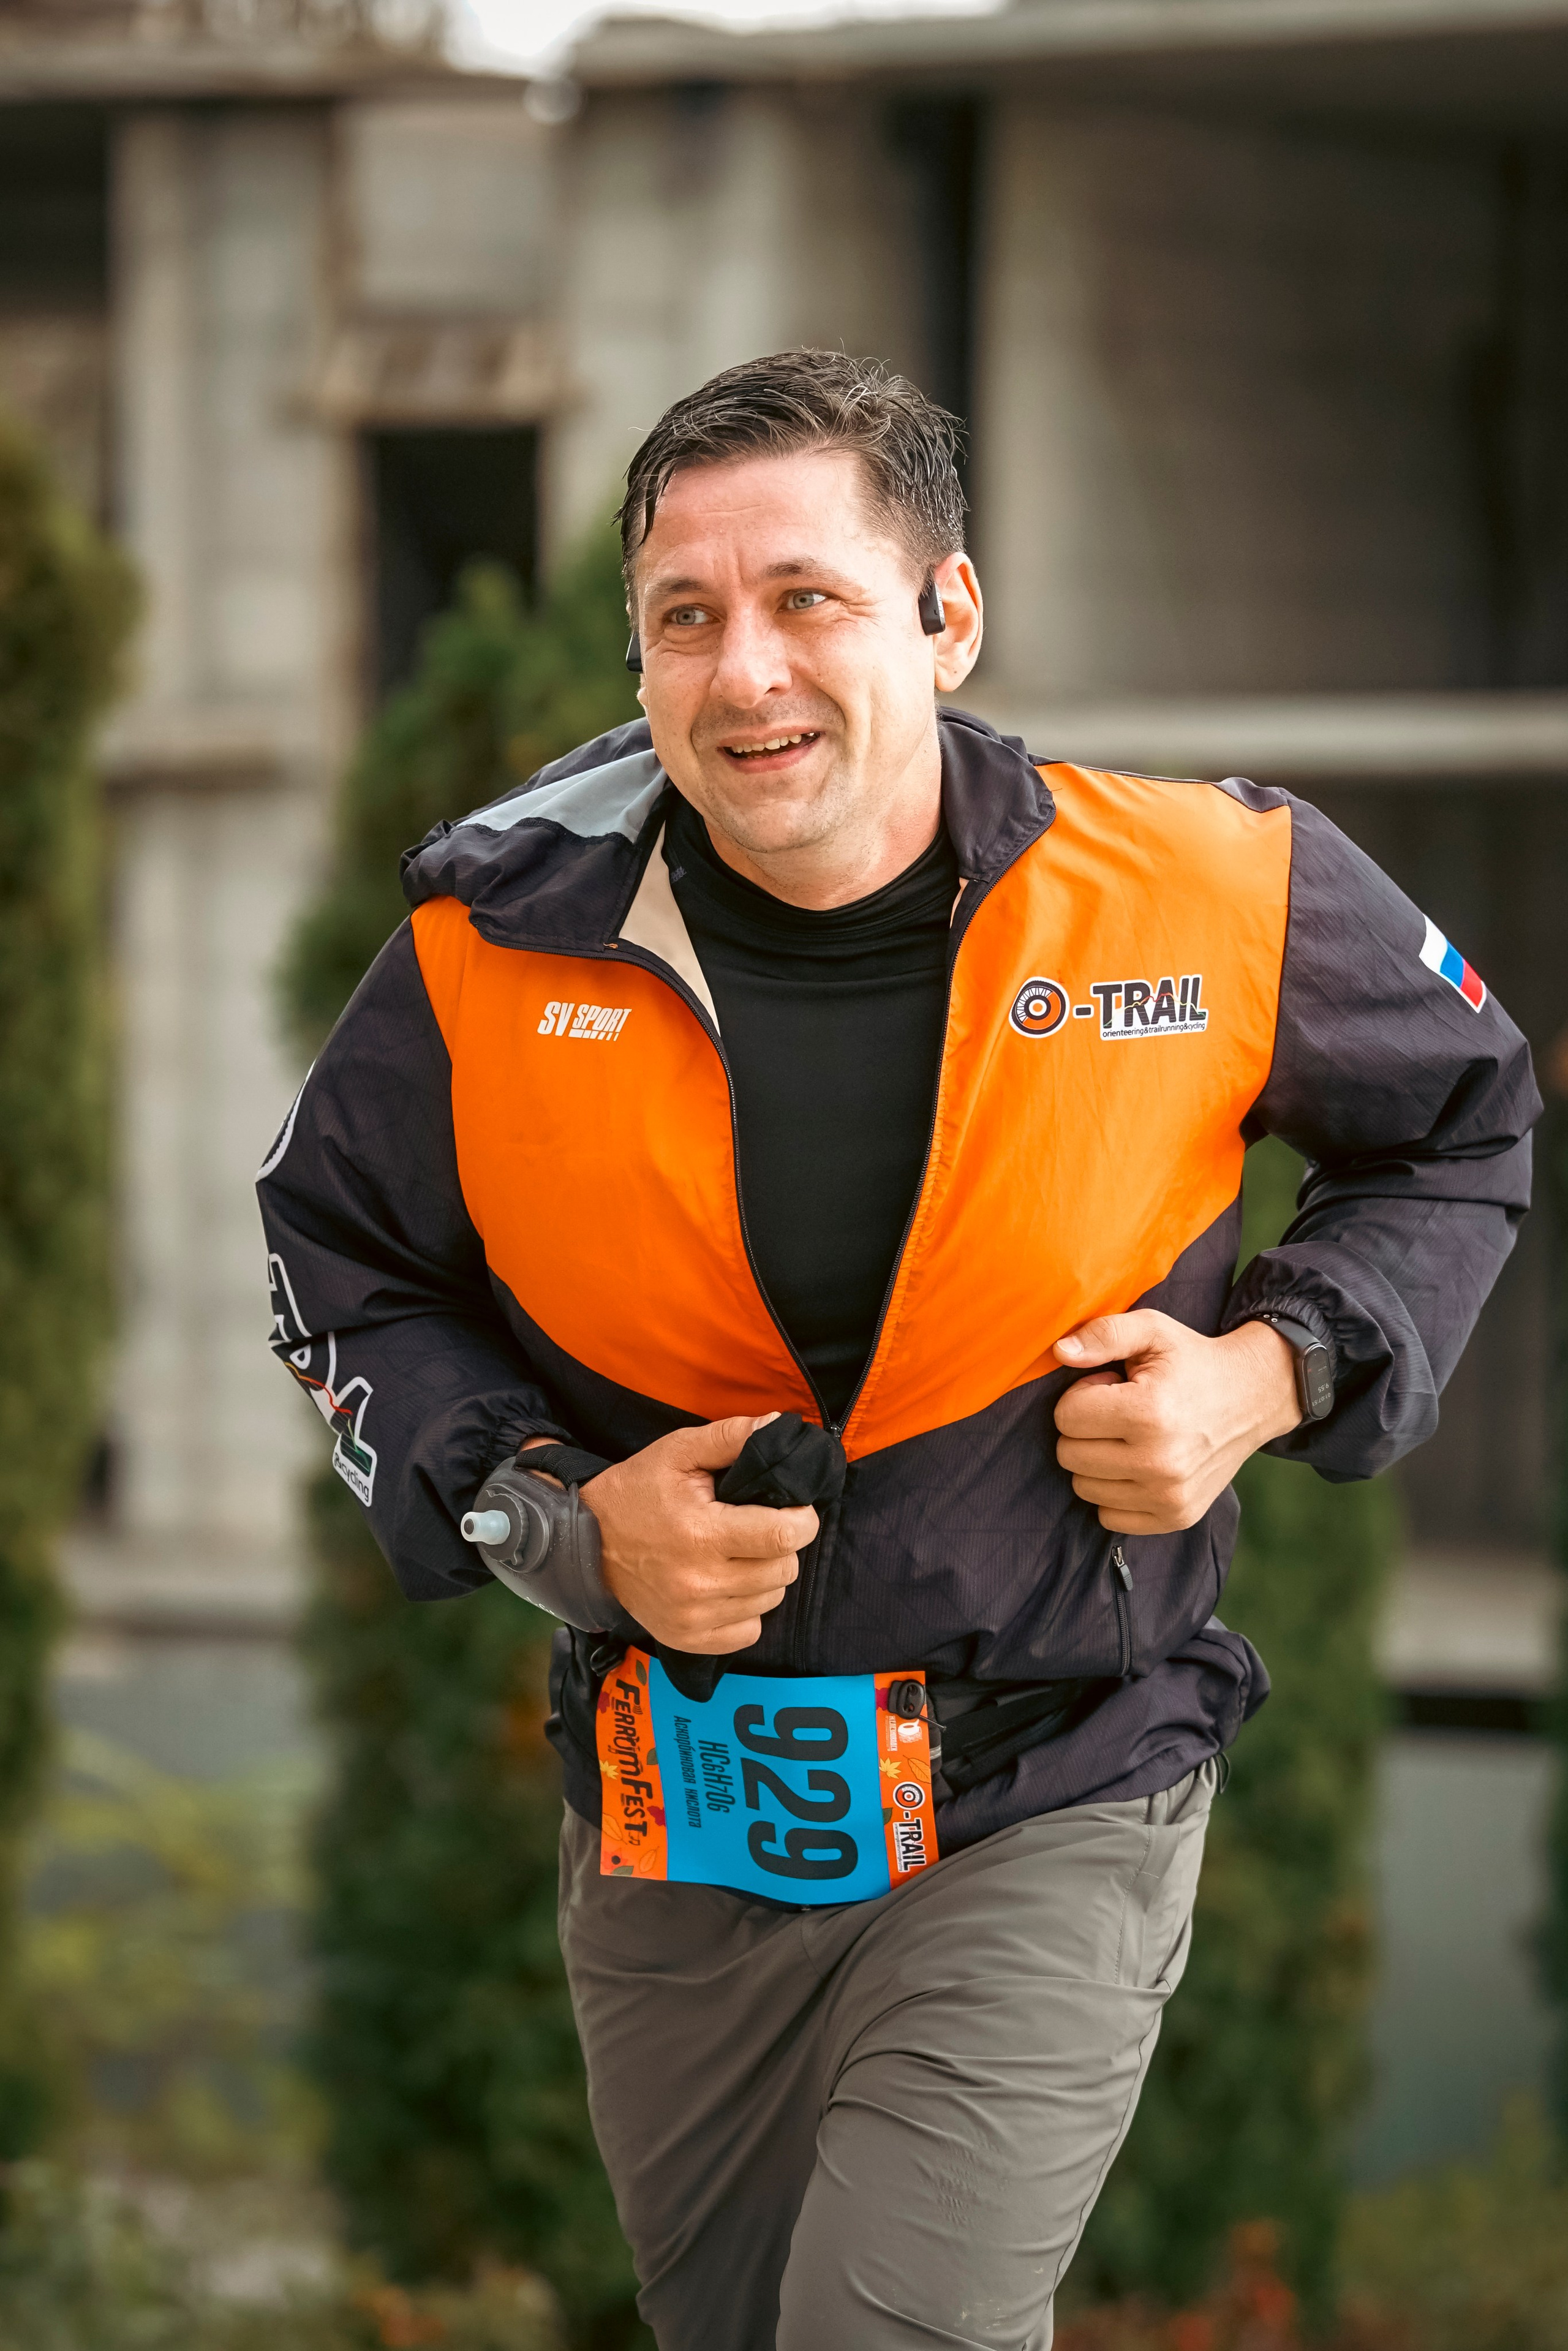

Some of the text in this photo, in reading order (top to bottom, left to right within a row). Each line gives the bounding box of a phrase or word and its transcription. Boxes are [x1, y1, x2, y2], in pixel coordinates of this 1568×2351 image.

[537, 1001, 633, 1036] SV SPORT
[1102, 1022, 1205, 1038] orienteering&trailrunning&cycling
[673, 1715, 702, 1828] Аскорбиновая кислота
[733, 1704, 858, 1880] 929
